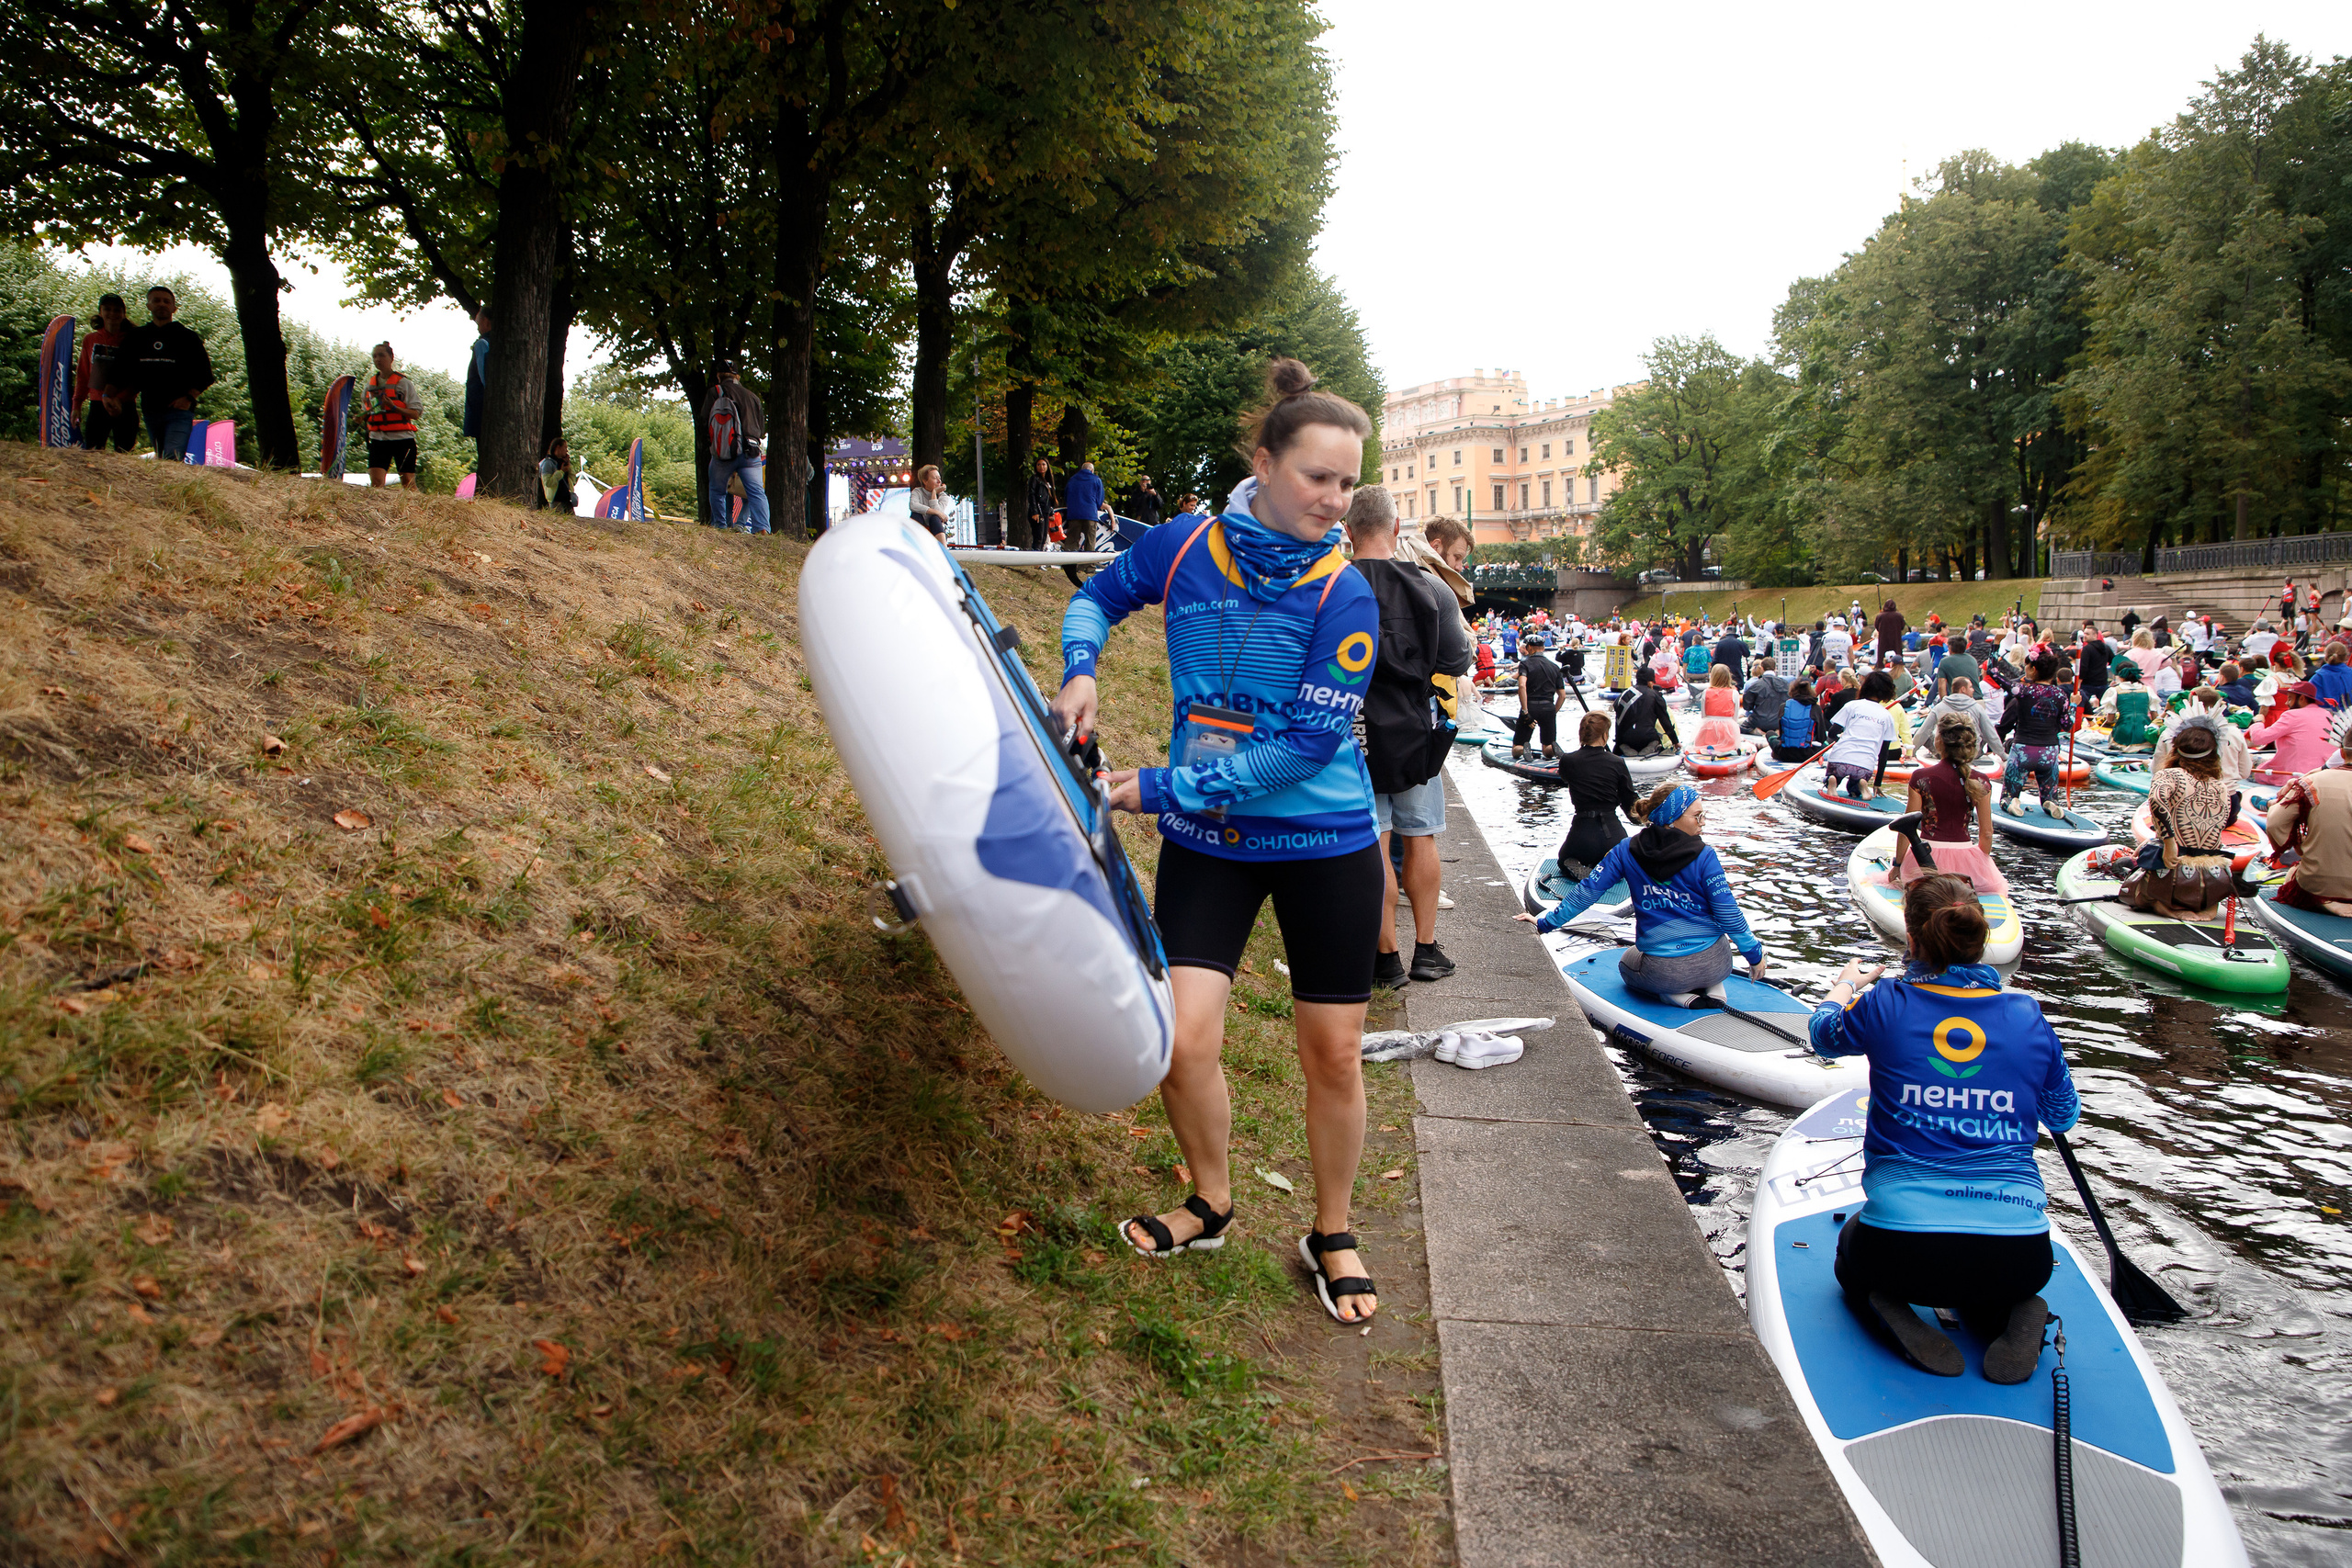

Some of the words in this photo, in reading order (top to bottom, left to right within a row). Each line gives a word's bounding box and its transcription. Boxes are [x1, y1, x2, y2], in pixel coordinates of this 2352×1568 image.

[51, 361, 64, 448] ПРОГРЕССА
[61, 405, 71, 448] ЕФТИ
[1291, 704, 1354, 737] онлай
[1161, 812, 1220, 845] лента
[1245, 829, 1338, 850] онлайн
[1909, 973, 1939, 984] ента
[1900, 1083, 2015, 1113] лента
[1893, 1113, 2023, 1142] онлайн
[1944, 1185, 2043, 1212] online.lenta.c
